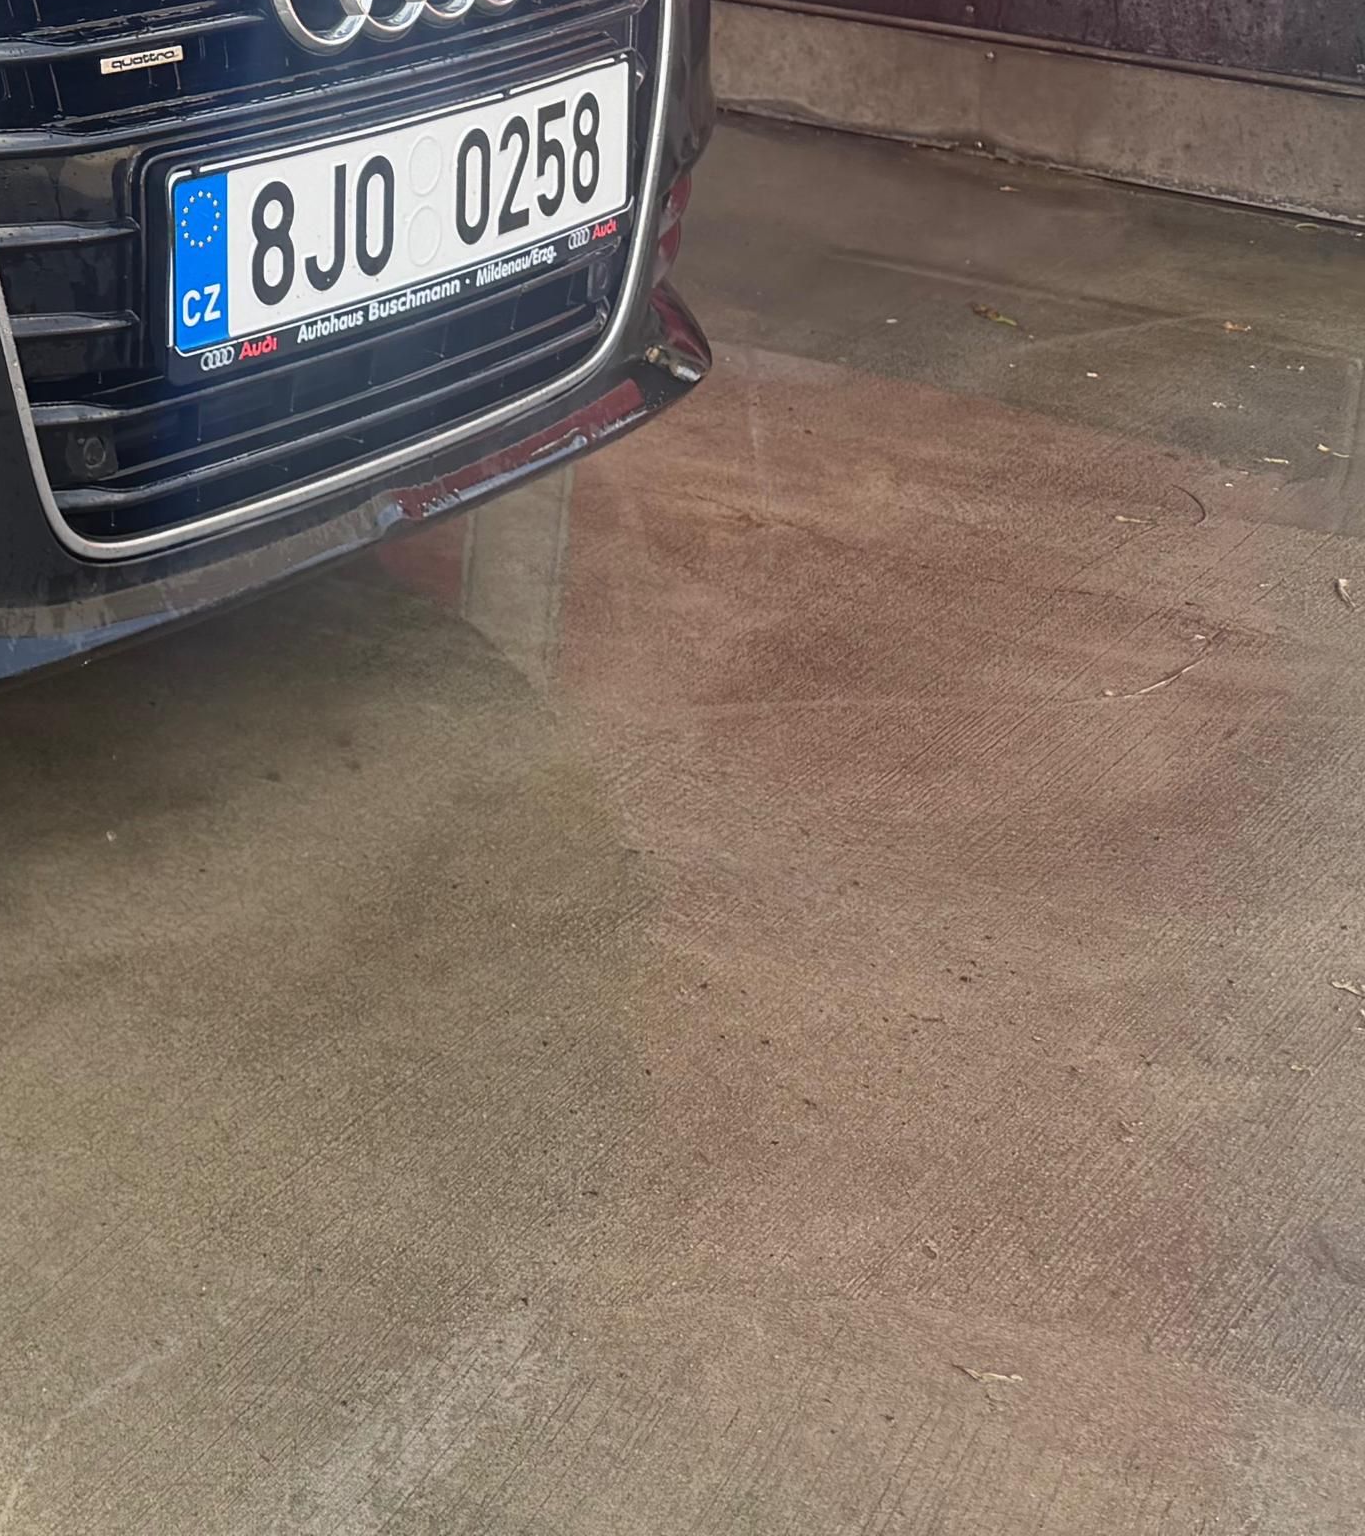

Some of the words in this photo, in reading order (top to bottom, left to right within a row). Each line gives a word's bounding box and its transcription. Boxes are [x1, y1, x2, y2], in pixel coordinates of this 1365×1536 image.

[111, 50, 175, 70] quattro
[251, 155, 395, 305] 8J0
[455, 92, 601, 247] 0258
[182, 284, 221, 328] CZ
[239, 336, 278, 361] Audi
[297, 310, 364, 344] Autohaus
[368, 279, 461, 322] Buschmann
[476, 244, 557, 288] Mildenau/Erzg.
[592, 221, 617, 241] Audi
